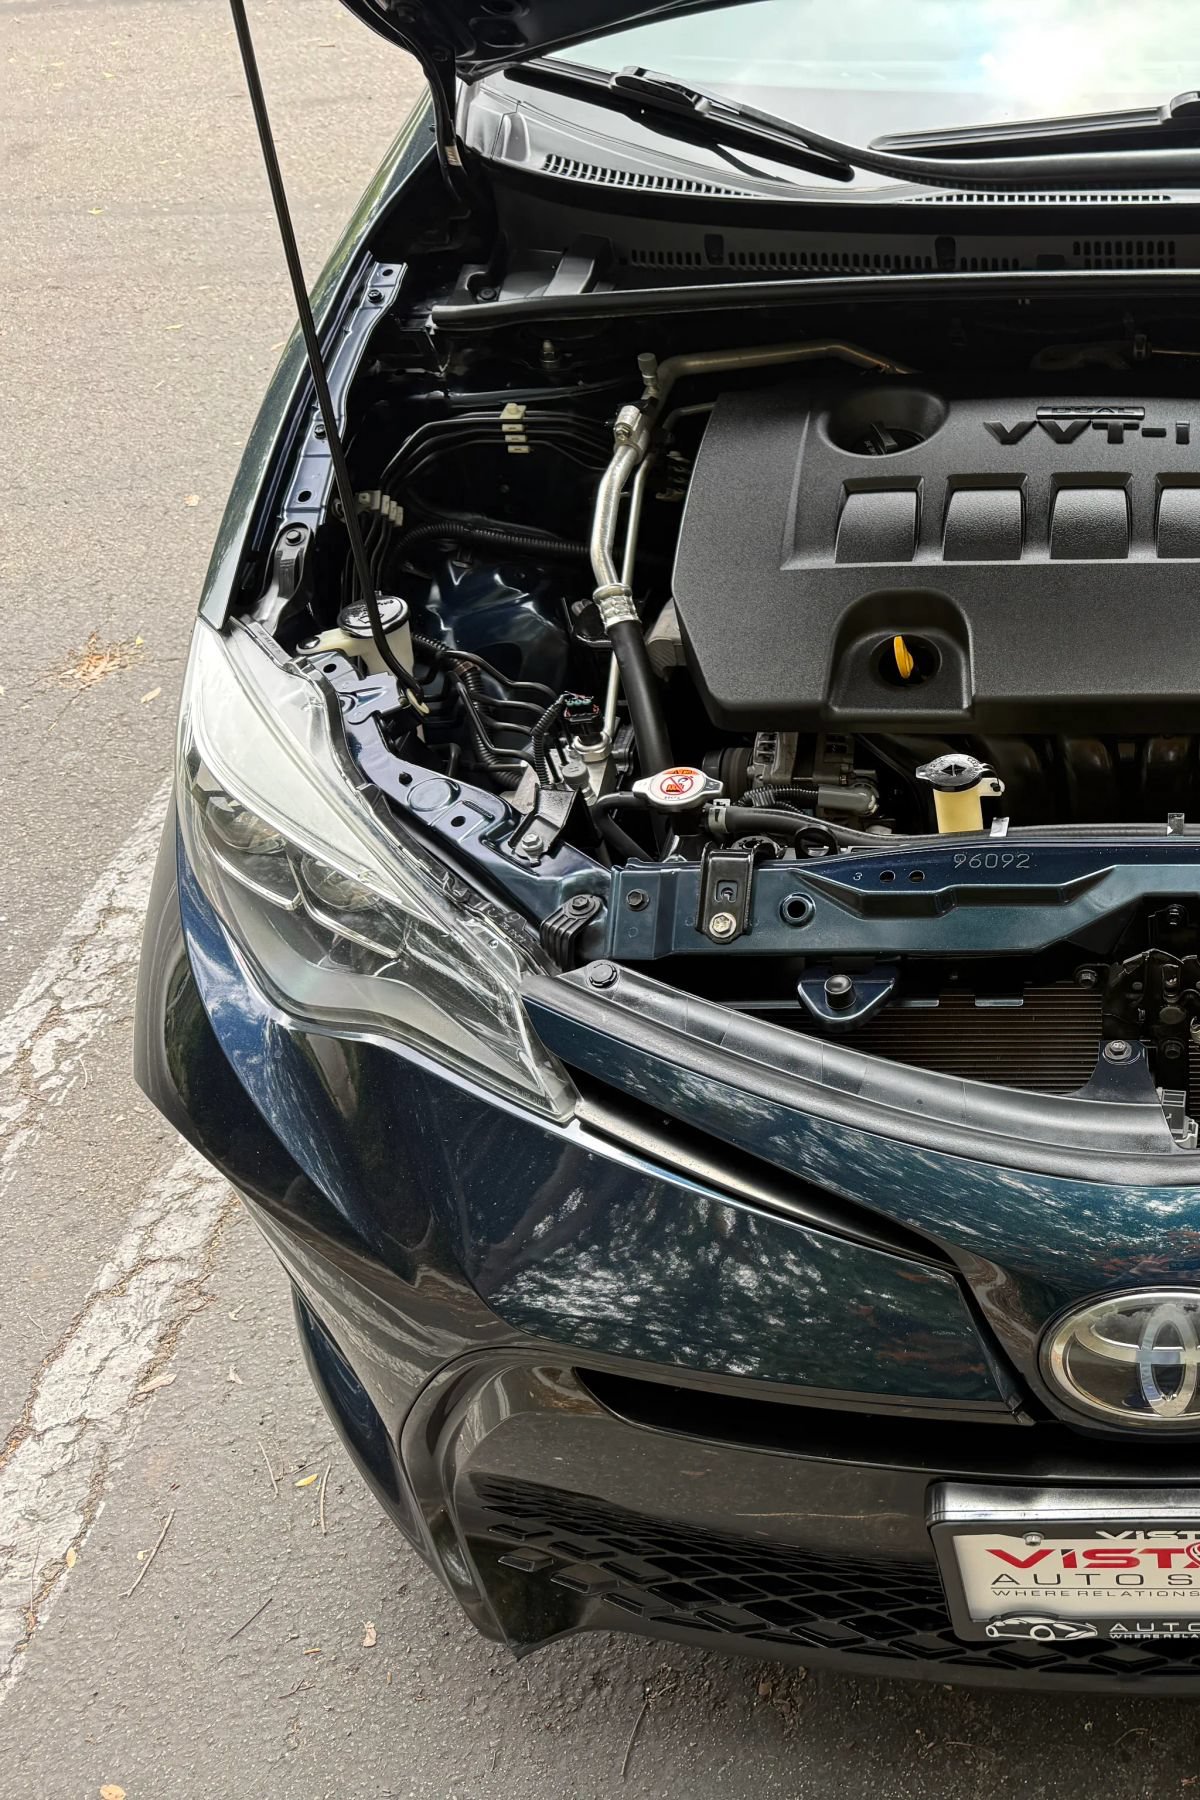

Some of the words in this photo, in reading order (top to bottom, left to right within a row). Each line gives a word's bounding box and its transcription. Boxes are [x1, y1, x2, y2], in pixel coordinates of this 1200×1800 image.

[1051, 406, 1137, 414] DUAL
[953, 853, 1031, 869] 96092
[853, 872, 863, 881] 3
[991, 1573, 1144, 1586] AUTO
